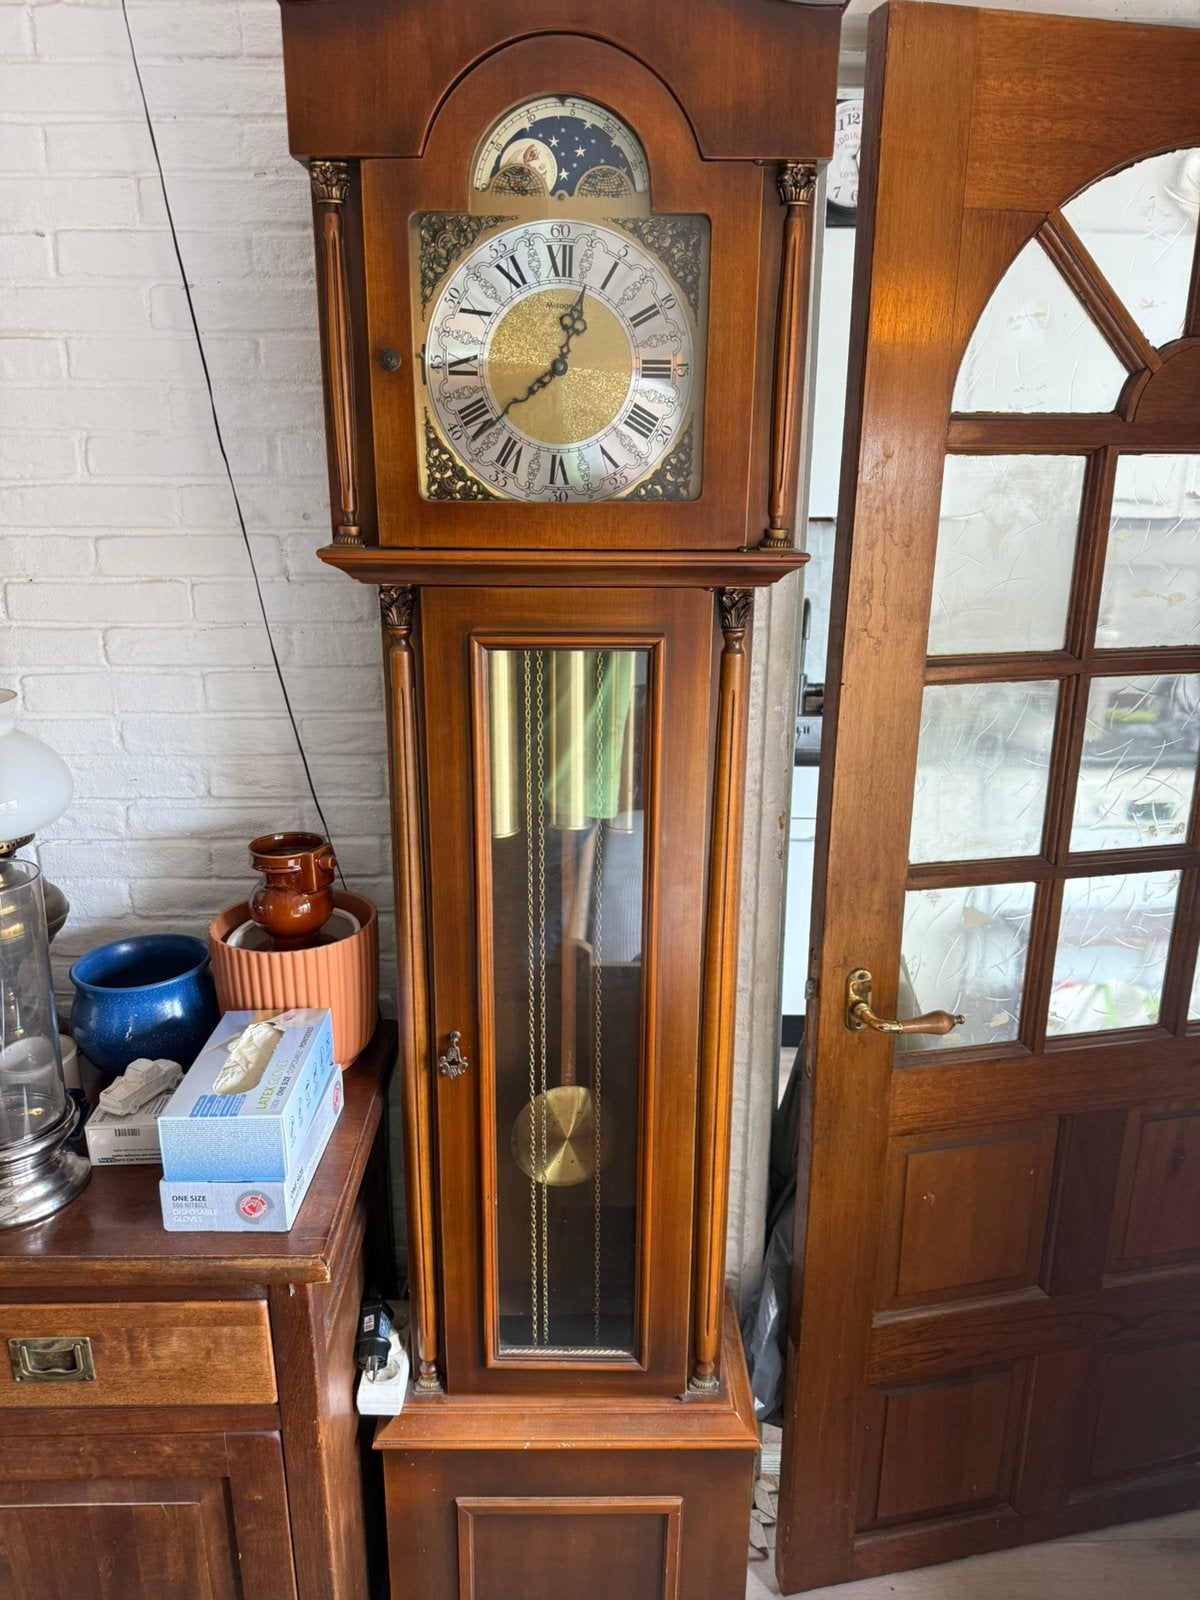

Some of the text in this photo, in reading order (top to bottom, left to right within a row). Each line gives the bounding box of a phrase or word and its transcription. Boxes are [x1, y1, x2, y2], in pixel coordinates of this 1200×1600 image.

[526, 114, 536, 122] 10
[570, 108, 576, 116] 5
[847, 112, 861, 125] 12
[836, 119, 846, 132] 1
[834, 186, 842, 198] 7
[550, 223, 571, 238] 60
[489, 240, 507, 258] 55
[617, 242, 630, 258] 5
[546, 244, 574, 278] XII
[496, 254, 528, 292] XI
[600, 262, 618, 290] I
[445, 287, 461, 309] 50
[662, 293, 677, 310] 10
[459, 298, 492, 324] X
[629, 304, 660, 327] II
[430, 354, 444, 374] 45
[448, 354, 478, 377] IX
[642, 359, 672, 379] III
[677, 362, 690, 378] 15
[458, 397, 493, 441] VIII
[624, 402, 660, 440] IIII
[448, 423, 462, 440] 40
[657, 426, 673, 446] 20
[496, 436, 524, 475] VII
[600, 444, 620, 474] V
[488, 470, 508, 488] 35
[550, 454, 570, 486] VI
[609, 474, 628, 490] 25
[548, 492, 569, 502] 30
[256, 1059, 287, 1109] LATEX GLOVES
[281, 1076, 291, 1085] SIZE
[276, 1086, 287, 1096] ONE
[190, 1194, 207, 1202] SIZE
[172, 1208, 219, 1216] DISPOSABLE
